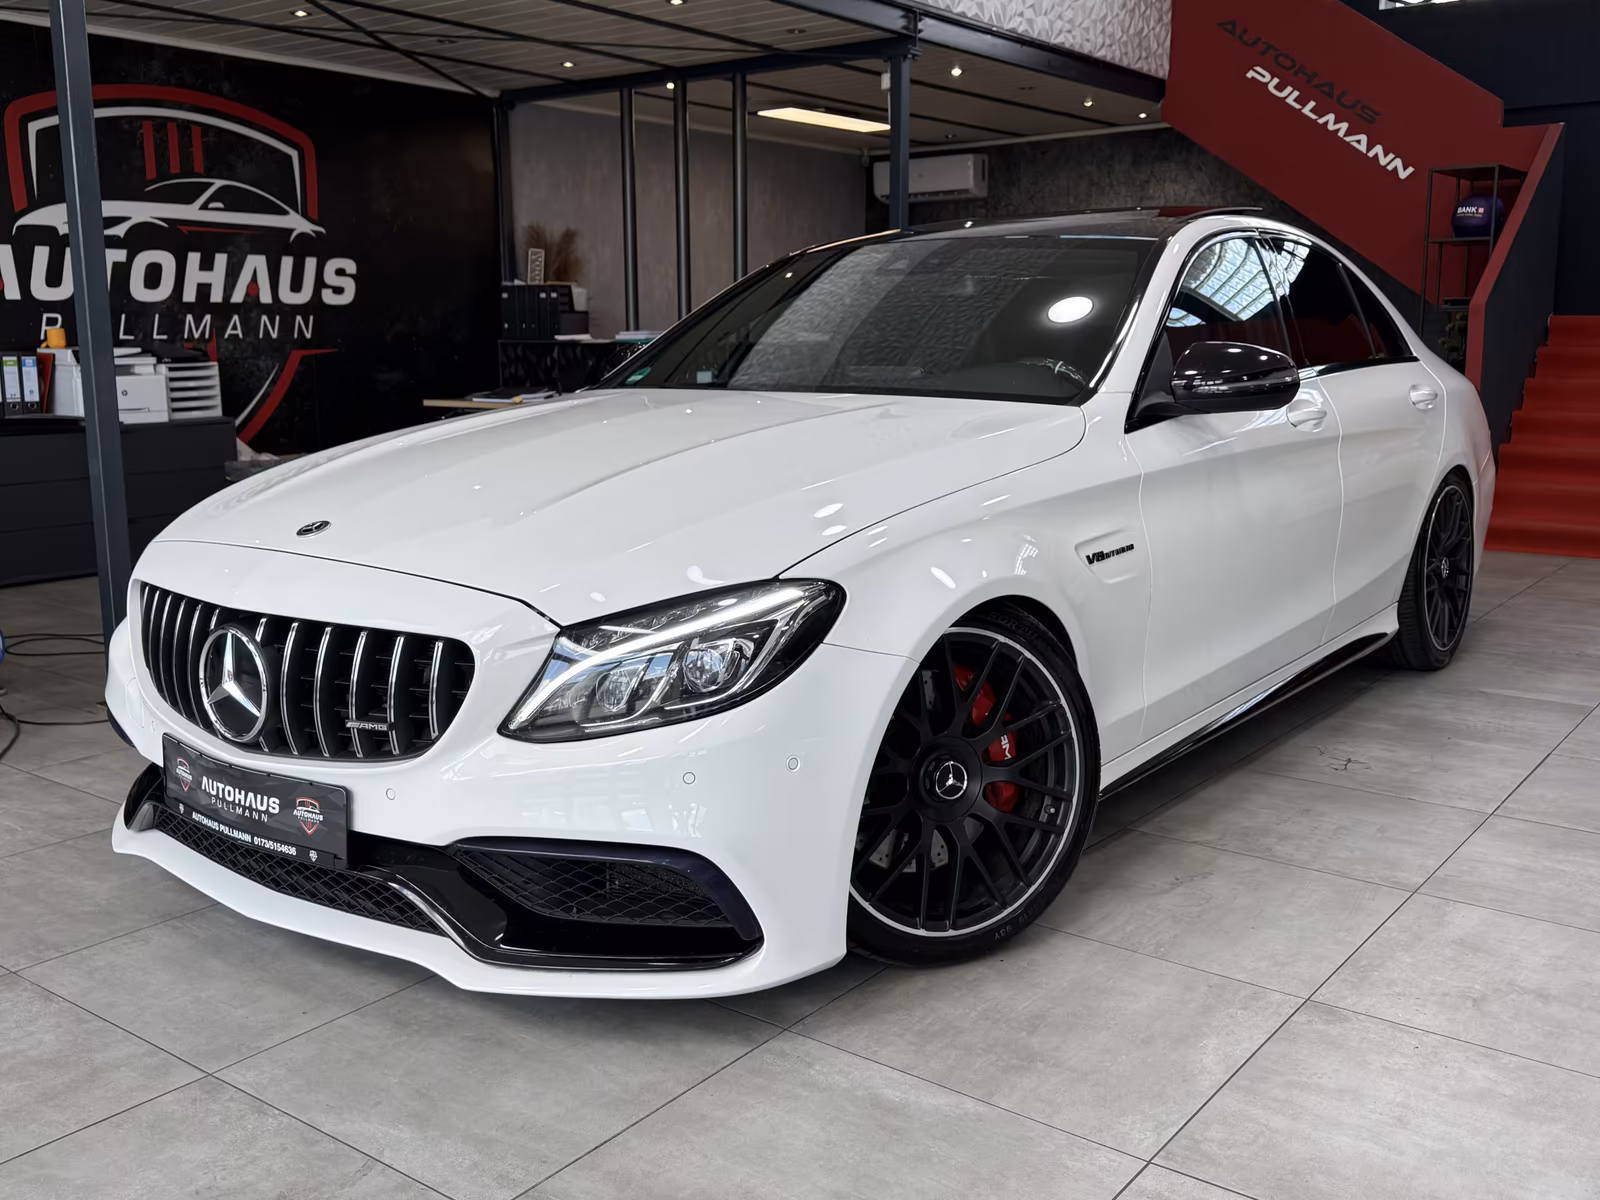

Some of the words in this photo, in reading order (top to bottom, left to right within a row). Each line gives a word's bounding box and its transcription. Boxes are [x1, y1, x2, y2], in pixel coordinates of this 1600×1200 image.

[1217, 18, 1381, 125] AUTOHAUS
[1245, 65, 1416, 180] PULLMANN
[1457, 206, 1477, 214] BANK
[40, 313, 314, 340] PLLMANN
[358, 722, 388, 731] AMG
[201, 775, 280, 814] AUTOHAUS
[211, 797, 268, 823] PULLMANN
[292, 809, 324, 821] AUTOHAUS
[192, 811, 219, 831] AUTOHAUS
[219, 824, 252, 843] PULLMANN
[253, 836, 297, 856] 0173/5154636
